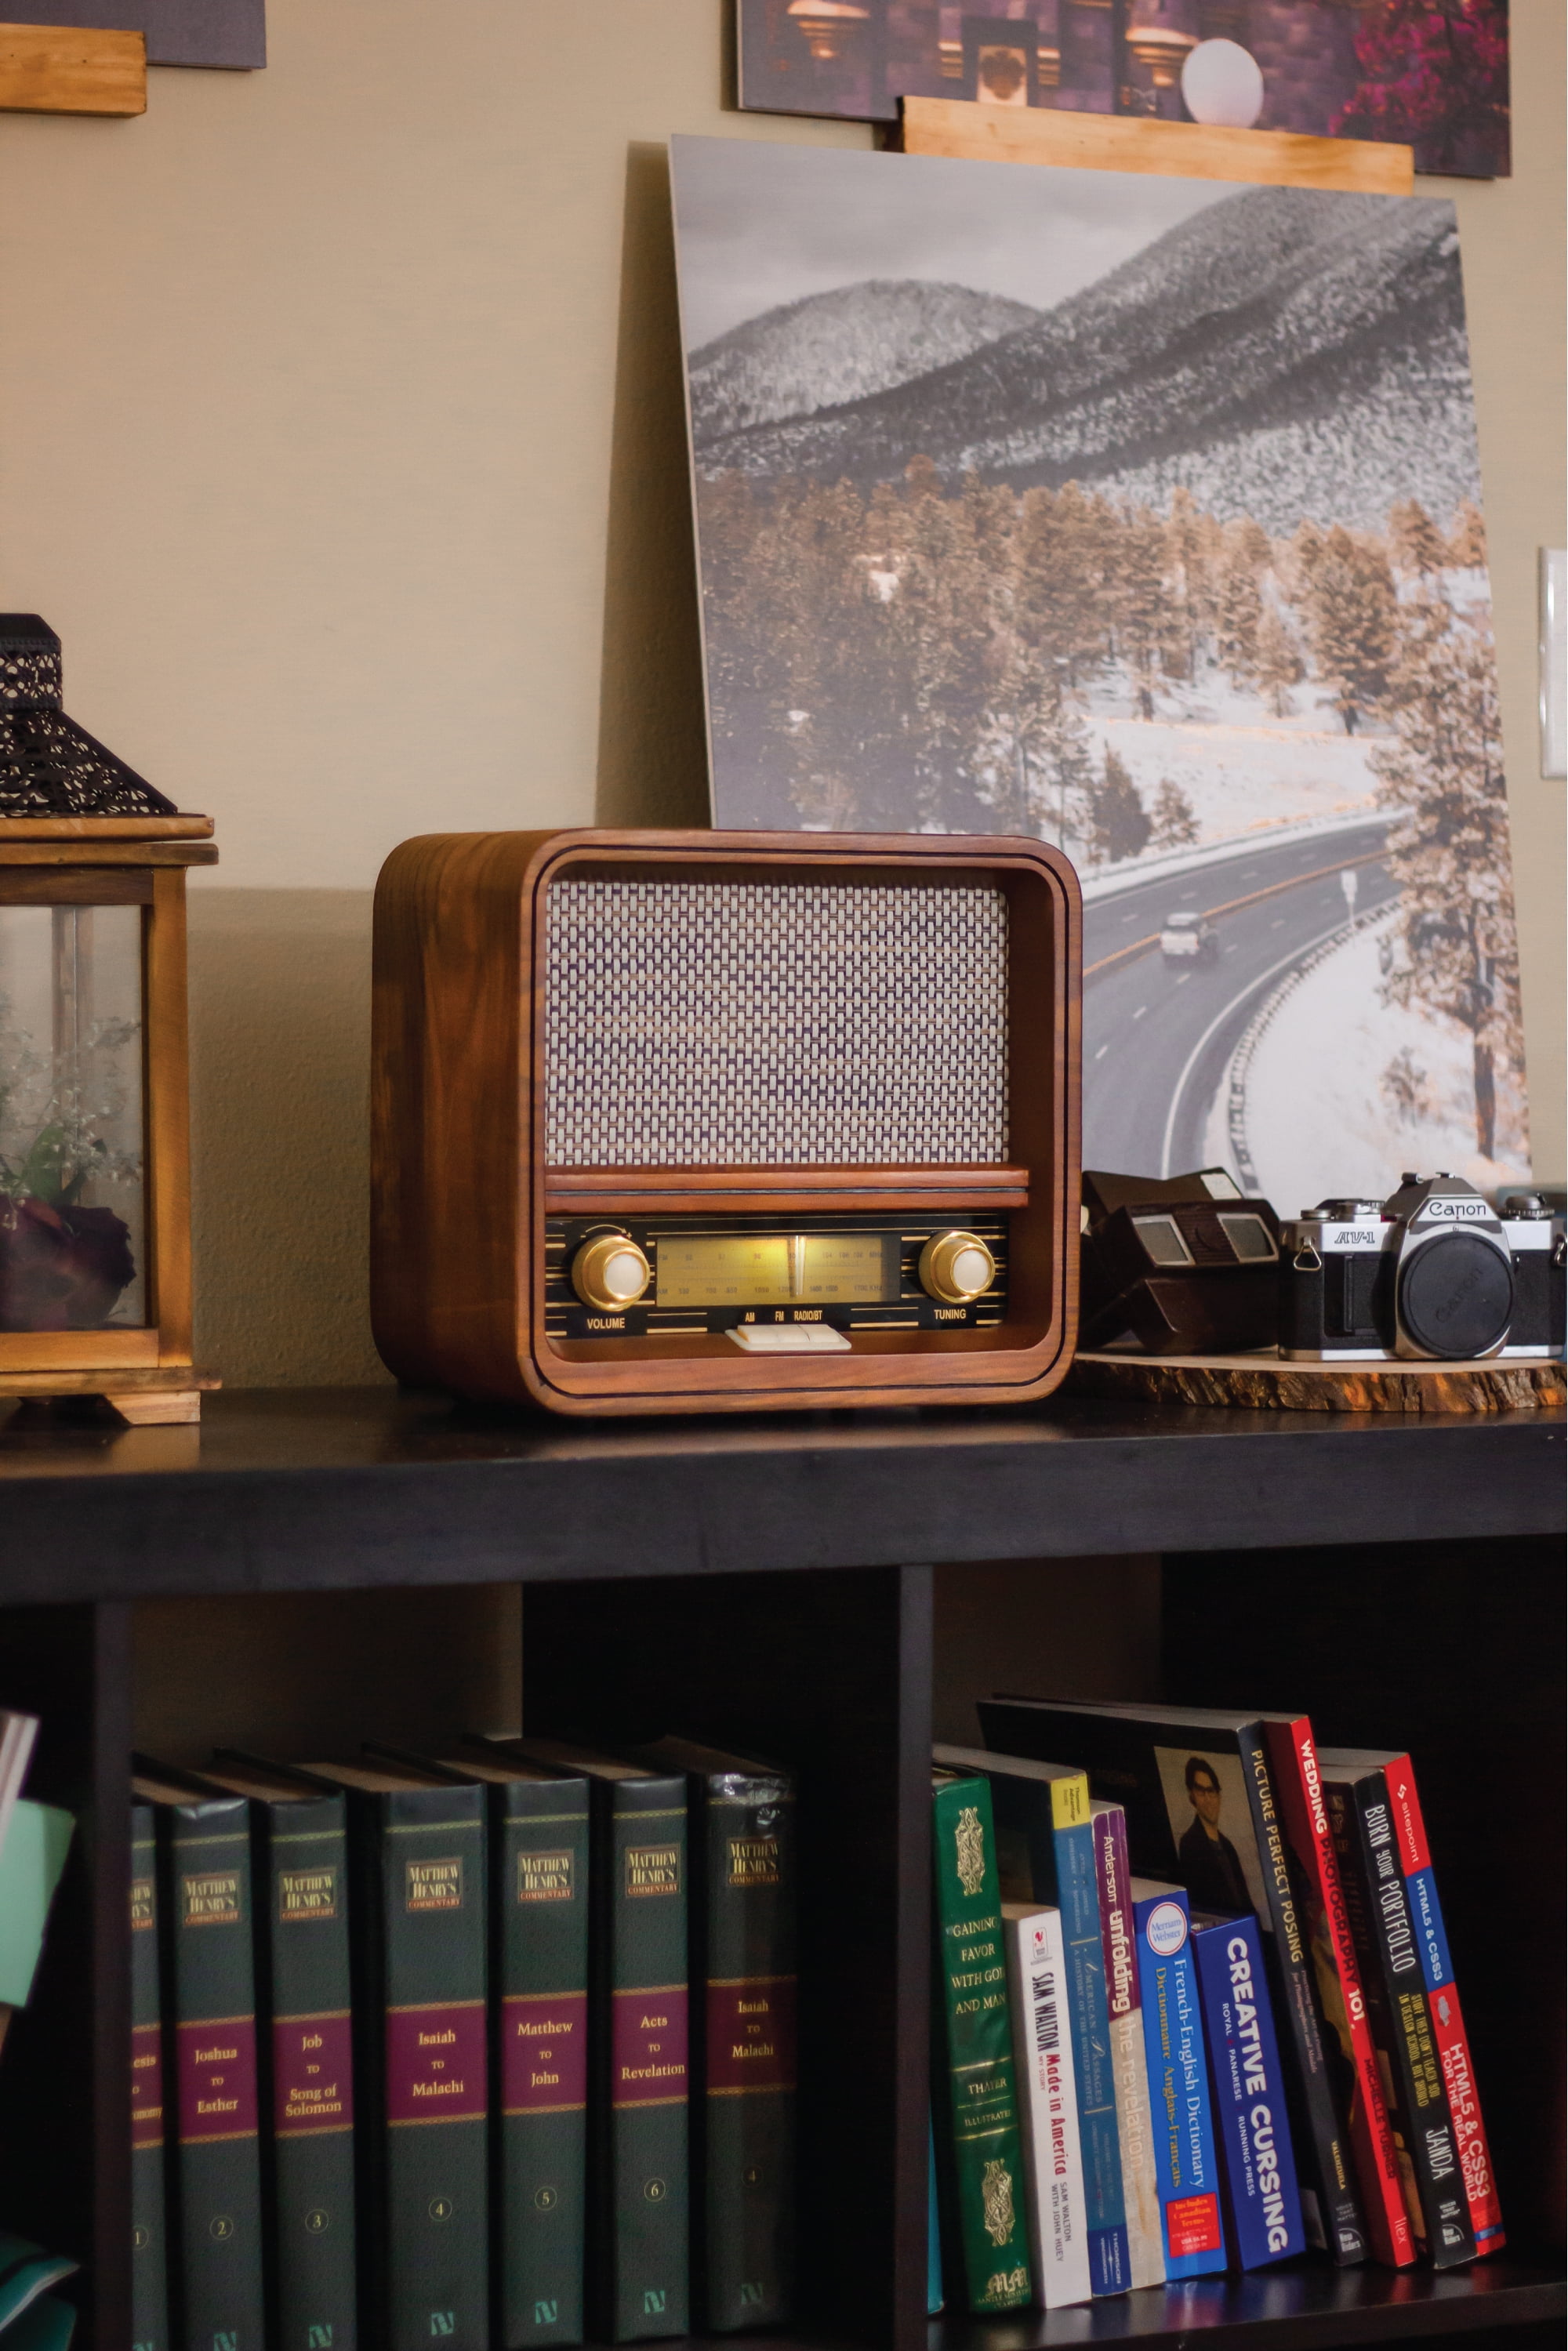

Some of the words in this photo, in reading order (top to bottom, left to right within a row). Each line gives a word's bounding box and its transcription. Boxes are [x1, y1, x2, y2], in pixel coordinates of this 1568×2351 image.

[1429, 1202, 1486, 1217] Canon
[1334, 1232, 1375, 1244] AV-1
[746, 1312, 755, 1322] AM
[775, 1311, 784, 1321] FM
[794, 1310, 822, 1321] RADIO/BT
[934, 1308, 967, 1320] TUNING
[586, 1318, 626, 1330] VOLUME
[1402, 1801, 1419, 1863] sitepoint
[731, 1843, 779, 1858] MATTHEW
[1252, 1750, 1276, 1822] PICTURE
[1266, 1824, 1290, 1895] PERFECT
[1281, 1899, 1304, 1963] POSING
[521, 1857, 570, 1873] MATTHEW
[629, 1852, 677, 1869] MATTHEW
[733, 1858, 777, 1874] HENRY'S
[410, 1865, 458, 1881] MATTHEW
[633, 1869, 674, 1885] HENRY'S
[1104, 1836, 1117, 1903] Anderson
[284, 1875, 332, 1892] MATTHEW
[524, 1874, 568, 1890] HENRY'S
[1301, 1739, 1327, 1834] WEDDING
[1320, 1836, 1358, 1990] PHOTOGRAPHY
[1348, 1989, 1365, 2022] 101
[1364, 1804, 1391, 1848] BURN
[1378, 1880, 1416, 1973] PORTFOLIO
[413, 1882, 456, 1899] HENRY'S
[521, 1890, 571, 1900] COMMENTARY
[628, 1884, 677, 1895] COMMENTARY
[286, 1892, 331, 1909] HENRY'S
[408, 1897, 460, 1909] COMMENTARY
[1416, 1878, 1433, 1927] HTML5
[1152, 1928, 1181, 1942] Webster
[1425, 1929, 1435, 1940] &
[961, 1943, 996, 1961] FAVOR
[1109, 1910, 1134, 2013] unfolding
[1428, 1943, 1443, 1982] CSS3
[952, 1972, 982, 1989] WITH
[1075, 1958, 1083, 1997] HISTORY
[1032, 1972, 1055, 2001] SAM
[738, 1999, 769, 2013] Isaiah
[956, 1999, 980, 2015] AND
[1079, 2000, 1085, 2011] OF
[1156, 1968, 1171, 2059] Dictionnaire
[517, 2020, 573, 2036] Matthew
[640, 2015, 668, 2029] Acts
[747, 2025, 760, 2034] TO
[1035, 2001, 1060, 2052] WALTON
[302, 2034, 323, 2052] Job
[419, 2029, 456, 2045] Isaiah
[1118, 2016, 1137, 2054] the
[195, 2047, 238, 2065] Joshua
[539, 2051, 552, 2059] TO
[648, 2044, 661, 2052] TO
[732, 2043, 775, 2058] Malachi
[1081, 2036, 1090, 2071] UNITED
[307, 2064, 320, 2074] TO
[432, 2060, 445, 2070] TO
[1038, 2055, 1044, 2066] MY
[1443, 2050, 1454, 2079] FOR
[532, 2071, 559, 2088] John
[622, 2063, 685, 2080] Revelation
[1046, 2054, 1062, 2094] Made
[1174, 1959, 1200, 2092] French-English
[1187, 2097, 1204, 2189] Dictionary
[1450, 2043, 1474, 2115] HTML5
[211, 2077, 224, 2086] TO
[412, 2080, 464, 2097] Malachi
[968, 2077, 1007, 2095] THAYER
[1084, 2073, 1093, 2106] STATES
[289, 2086, 321, 2101] Song
[325, 2083, 337, 2097] of
[1222, 2002, 1232, 2036] ROYAL
[1229, 2048, 1243, 2101] PANARESE
[1238, 2116, 1250, 2164] RUNNING
[1246, 2165, 1255, 2197] PRESS
[1227, 1936, 1266, 2096] CREATIVE
[1250, 2104, 1288, 2254] CURSING
[1447, 2081, 1460, 2108] THE
[198, 2098, 238, 2114] Esther
[285, 2101, 342, 2117] Solomon
[1050, 2097, 1065, 2112] in
[1122, 2058, 1145, 2170] revelation
[1364, 2059, 1383, 2124] MICHELLE
[1378, 2126, 1396, 2180] TURNER
[1162, 2066, 1181, 2188] Anglais-Français
[1454, 2114, 1467, 2150] REAL
[1465, 2121, 1478, 2136] &
[1051, 2117, 1069, 2175] America
[1425, 2125, 1455, 2180] JANDA
[750, 2170, 757, 2183] 4
[1461, 2151, 1477, 2202] WORLD
[1468, 2139, 1490, 2198] CSS3
[543, 2193, 550, 2205] 5
[651, 2184, 659, 2197] 6
[1060, 2182, 1069, 2202] SAM
[436, 2203, 444, 2216] 4
[218, 2222, 227, 2235] 2
[314, 2215, 321, 2228] 3
[1062, 2206, 1072, 2242] WALTON
[1054, 2237, 1064, 2262] HUEY
[1113, 2233, 1122, 2284] THOMSON
